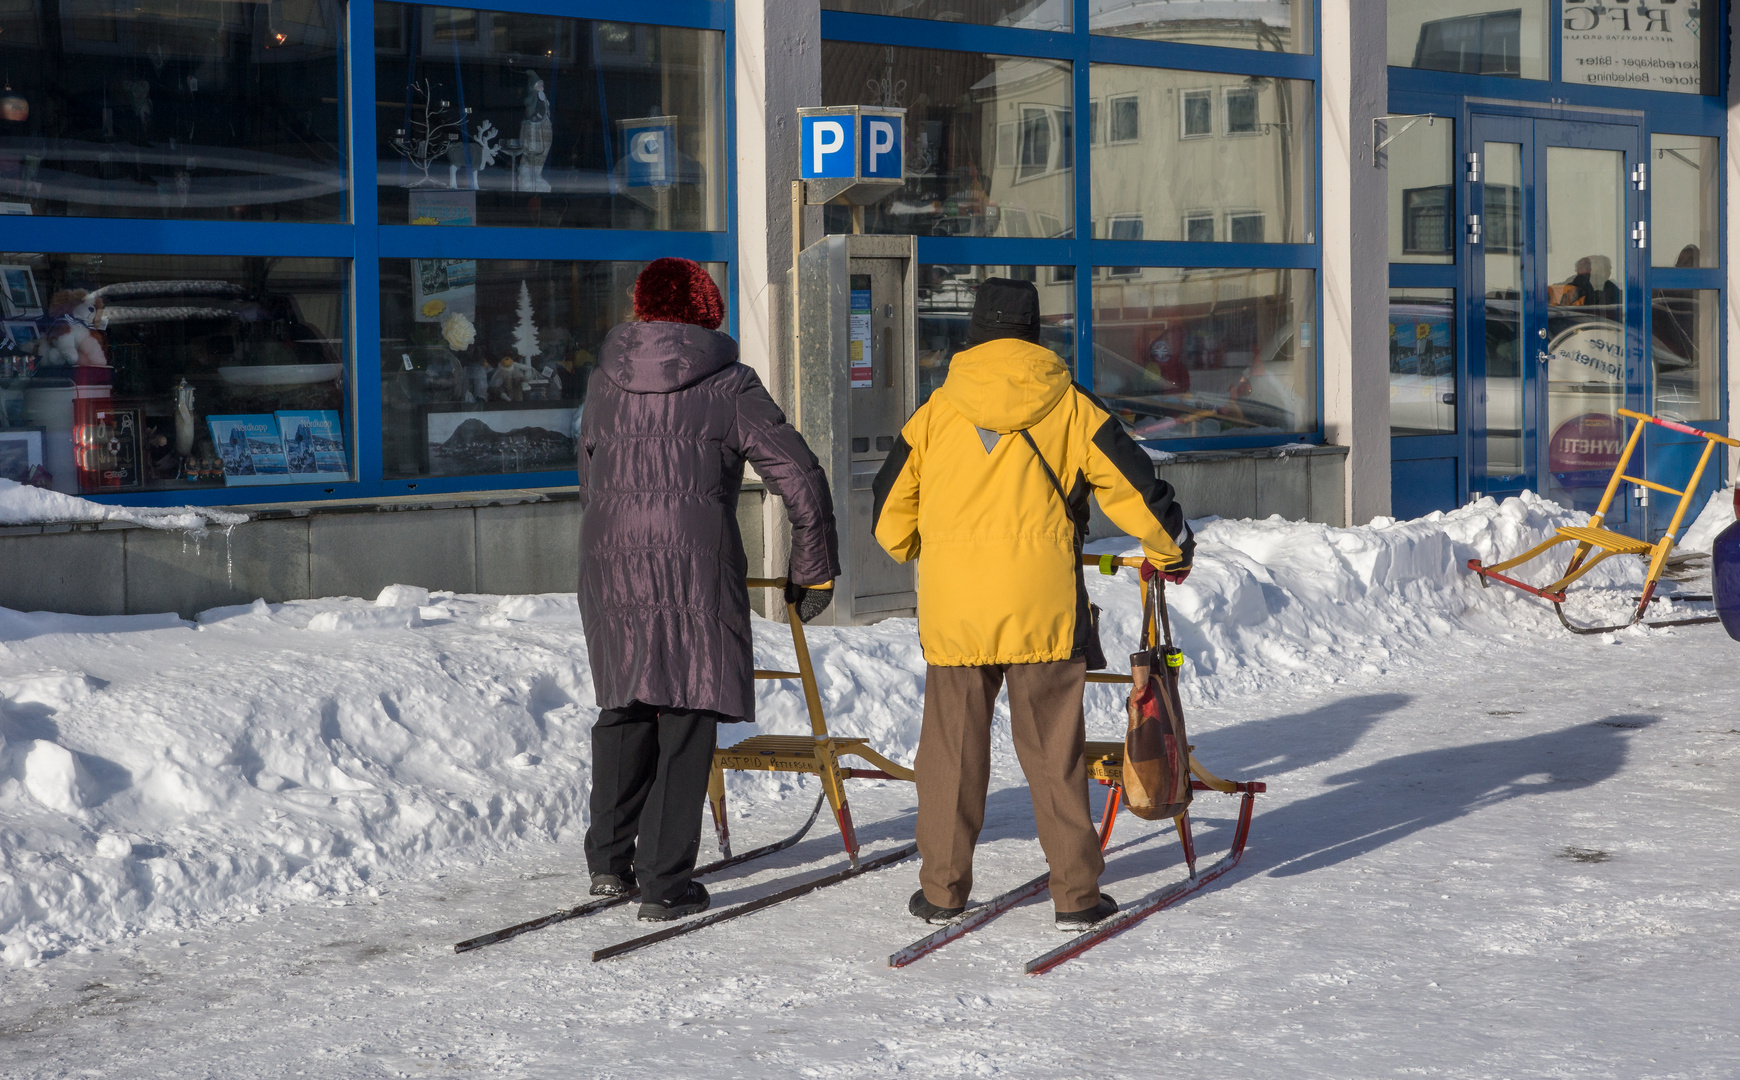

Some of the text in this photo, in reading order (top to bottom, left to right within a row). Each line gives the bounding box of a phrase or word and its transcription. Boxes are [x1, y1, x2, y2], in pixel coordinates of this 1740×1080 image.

[813, 121, 844, 173] P
[869, 121, 894, 172] P
[233, 423, 268, 433] Nordkapp
[301, 419, 333, 429] Nordkapp
[720, 756, 762, 768] ASTRID
